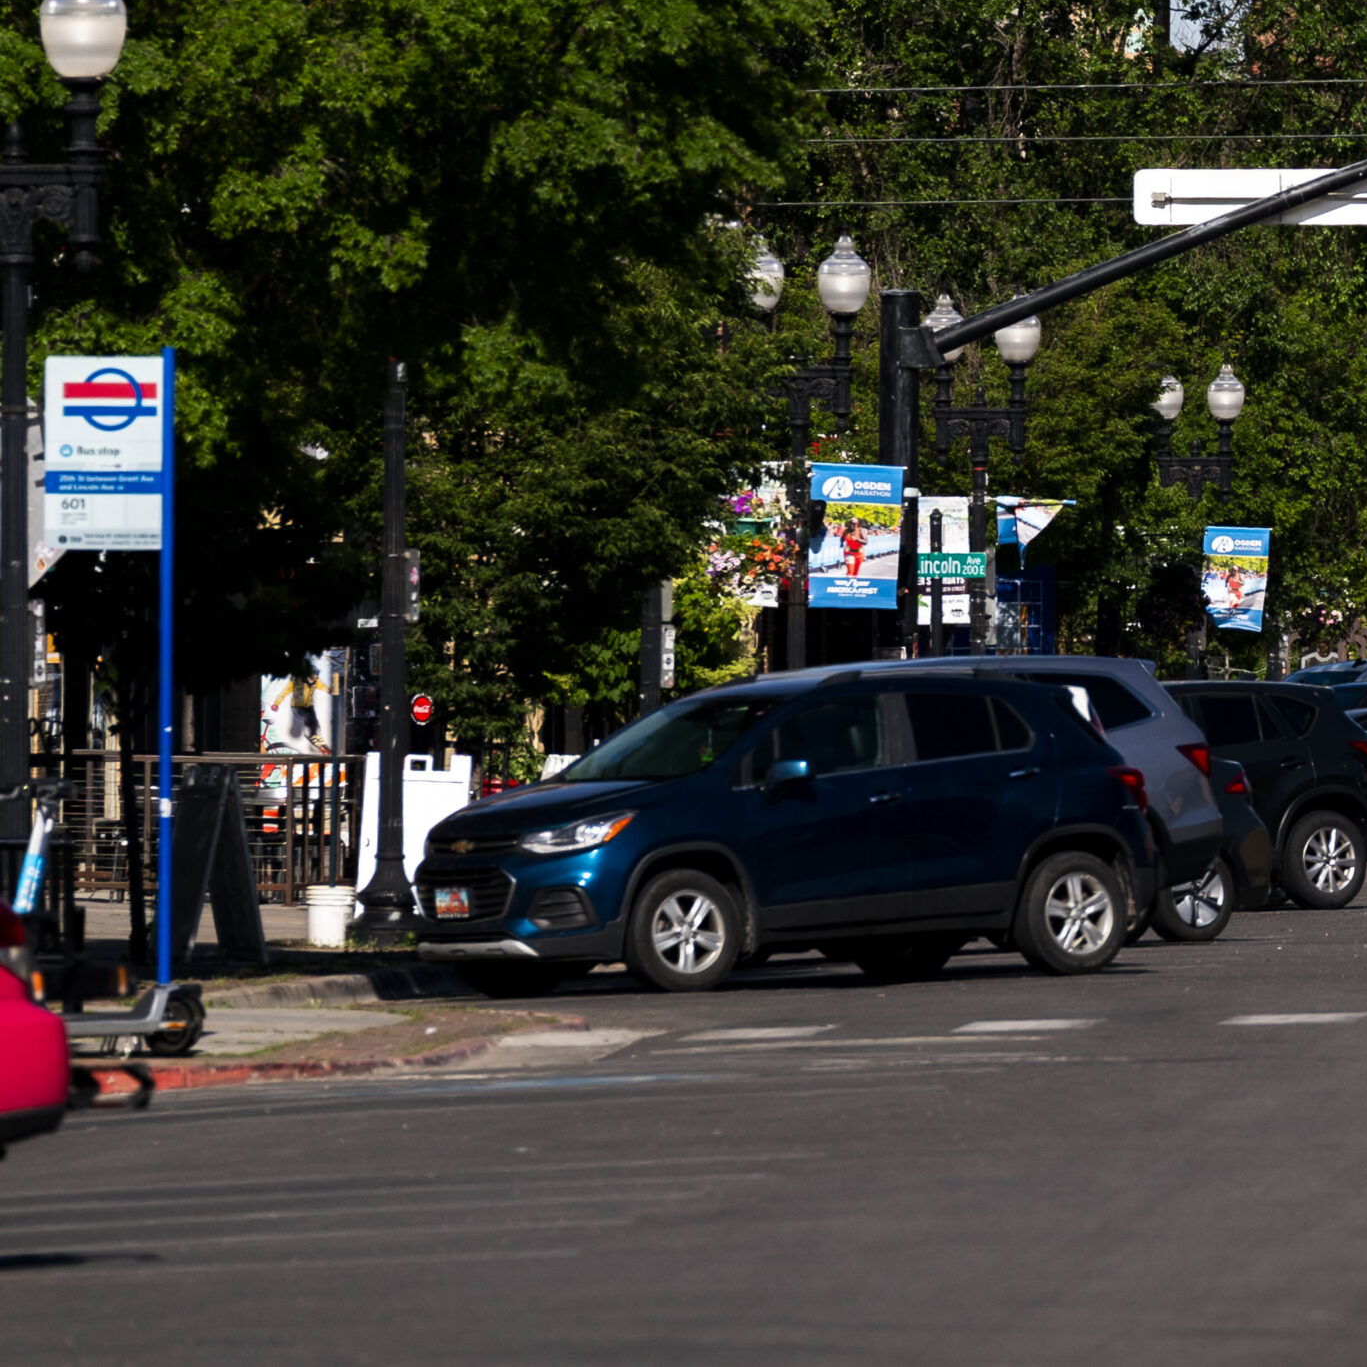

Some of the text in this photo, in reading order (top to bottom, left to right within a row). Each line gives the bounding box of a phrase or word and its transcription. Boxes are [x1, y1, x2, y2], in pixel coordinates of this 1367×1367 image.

[77, 446, 120, 456] Bus stop
[854, 481, 891, 490] OGDEN
[853, 489, 891, 497] MARATHON
[61, 498, 85, 509] 601
[1234, 539, 1262, 547] OGDEN
[966, 556, 981, 565] Ave
[962, 566, 985, 575] 200 E
